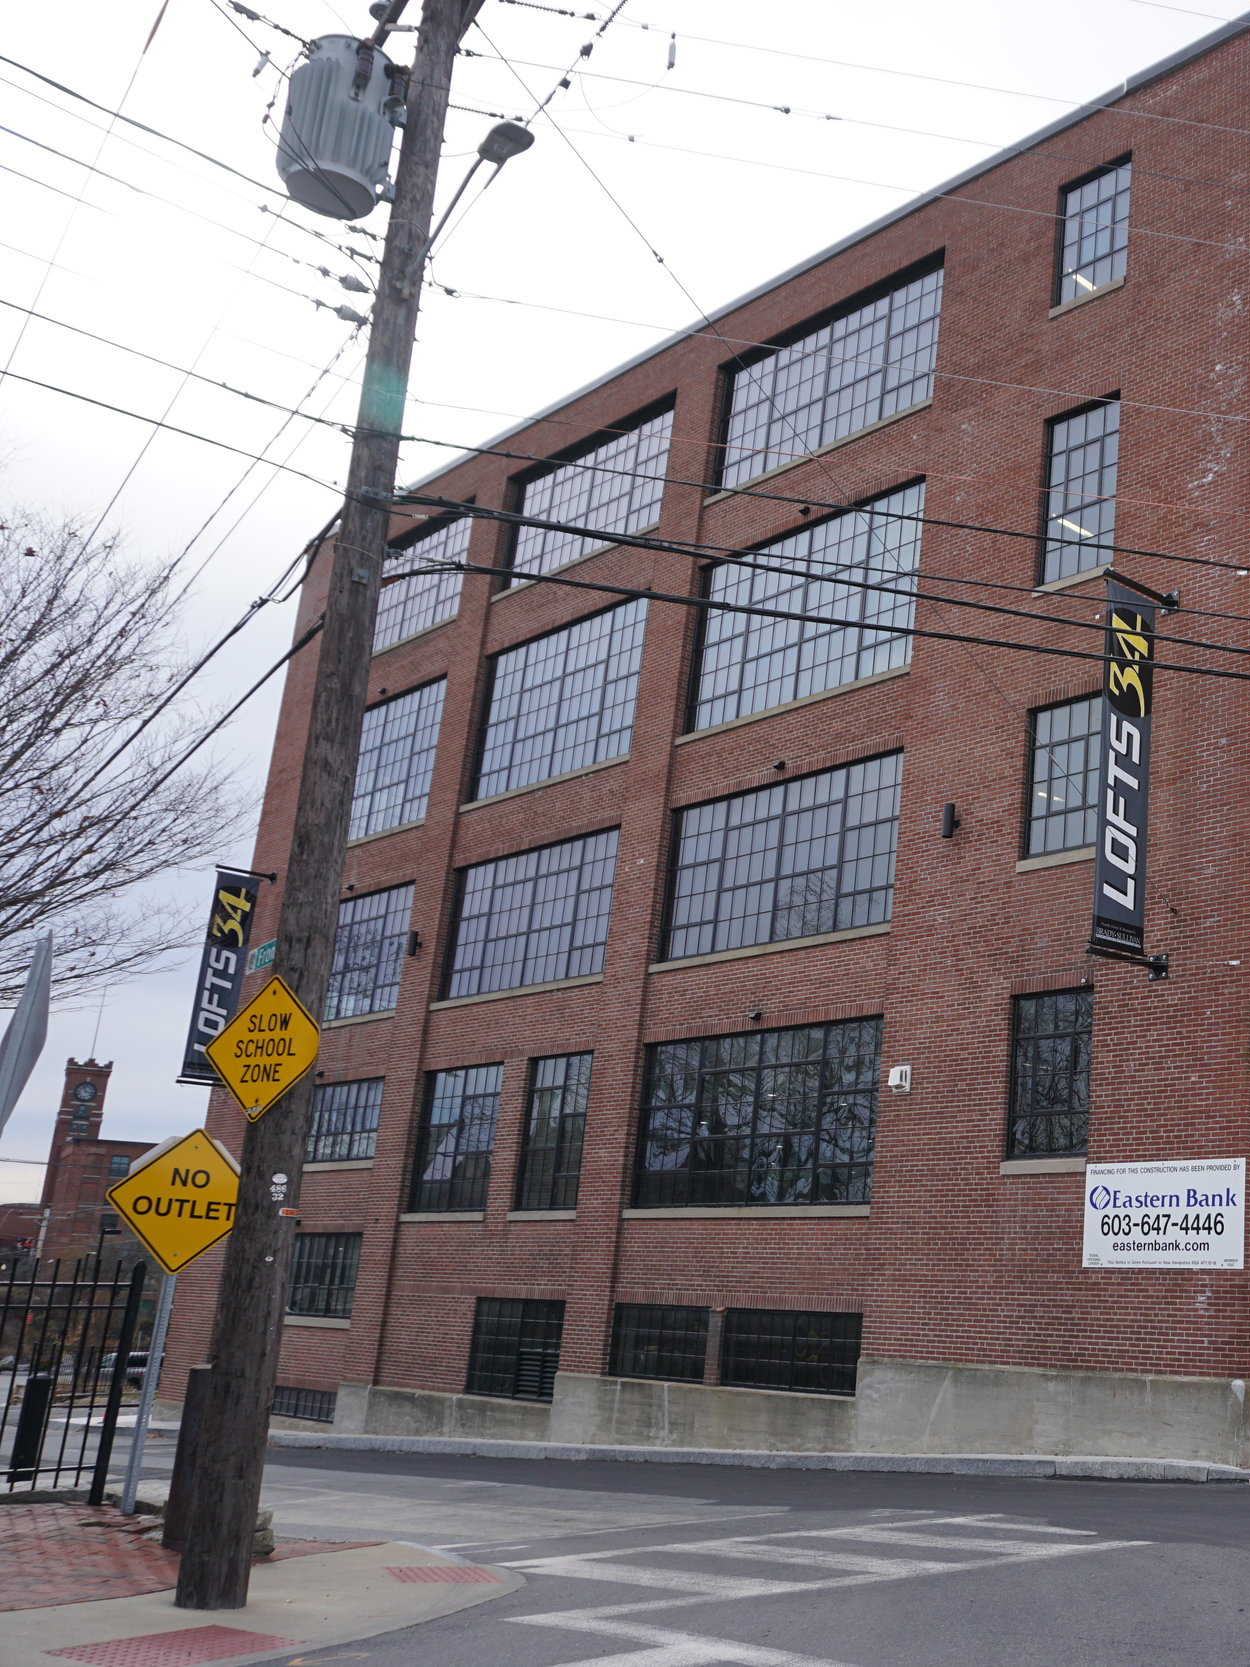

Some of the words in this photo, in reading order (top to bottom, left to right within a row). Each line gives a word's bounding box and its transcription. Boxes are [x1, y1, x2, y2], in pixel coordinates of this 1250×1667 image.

[1109, 612, 1149, 718] 34
[1103, 712, 1141, 911] LOFTS
[212, 888, 251, 947] 34
[248, 1013, 292, 1032] SLOW
[234, 1037, 296, 1058] SCHOOL
[240, 1063, 282, 1083] ZONE
[170, 1167, 210, 1188] NO
[1140, 1166, 1178, 1174] CONSTRUCTION
[1206, 1164, 1232, 1172] PROVIDED
[1233, 1163, 1241, 1171] BY
[132, 1195, 237, 1221] OUTLET
[1112, 1190, 1180, 1209] Eastern
[1186, 1187, 1238, 1208] Bank
[1101, 1212, 1225, 1236] 603-647-4446
[1112, 1239, 1210, 1251] easternbank.com
